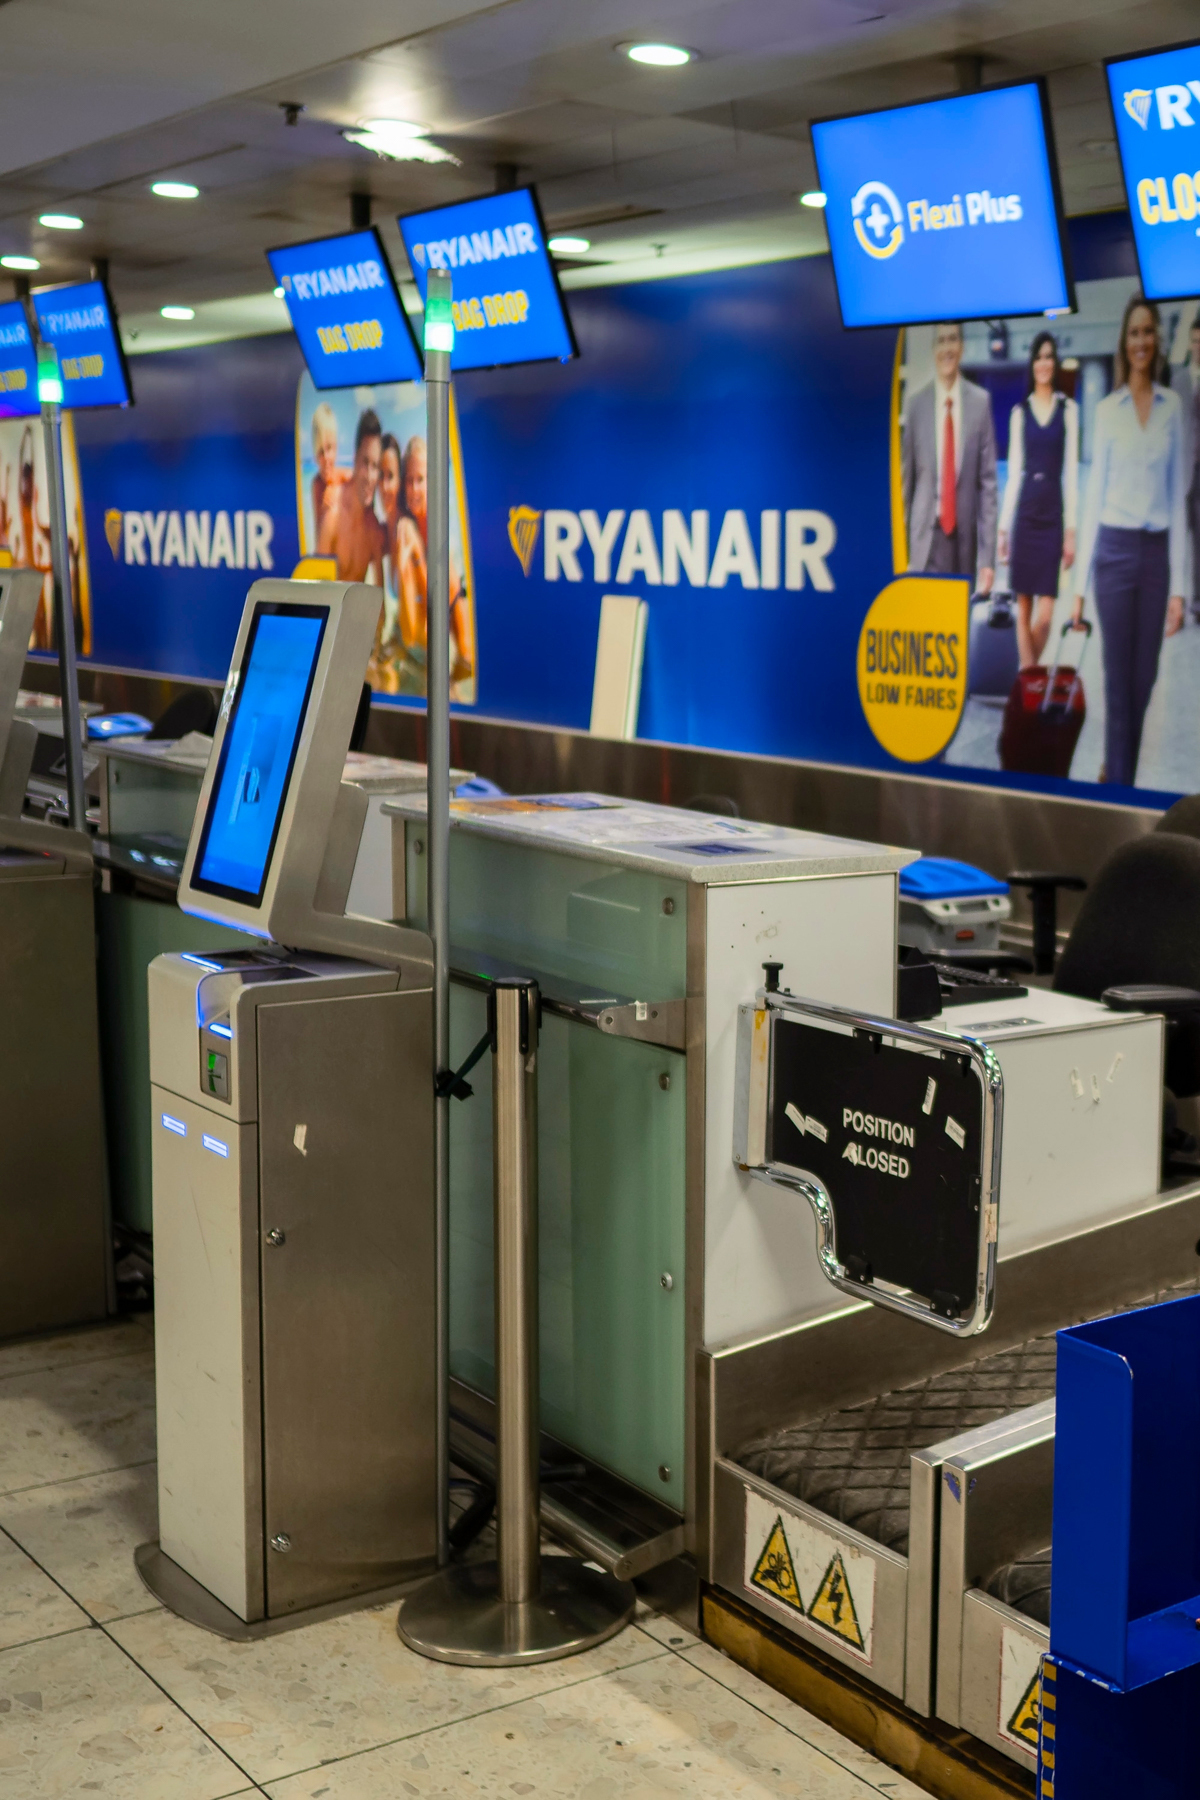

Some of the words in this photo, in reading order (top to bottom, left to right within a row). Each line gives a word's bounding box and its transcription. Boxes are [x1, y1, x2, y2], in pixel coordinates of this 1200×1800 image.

[907, 194, 964, 232] Flexi
[966, 190, 1022, 225] Plus
[426, 222, 538, 269] RYANAIR
[292, 260, 385, 300] RYANAIR
[48, 304, 106, 335] RYANAIR
[452, 297, 486, 332] BAG
[482, 289, 529, 327] DROP
[317, 324, 348, 354] BAG
[344, 319, 383, 351] DROP
[124, 510, 274, 570] RYANAIR
[543, 509, 836, 592] RYANAIR
[867, 629, 958, 679] BUSINESS
[867, 683, 900, 704] LOW
[905, 685, 957, 711] FARES
[843, 1108, 915, 1148] POSITION
